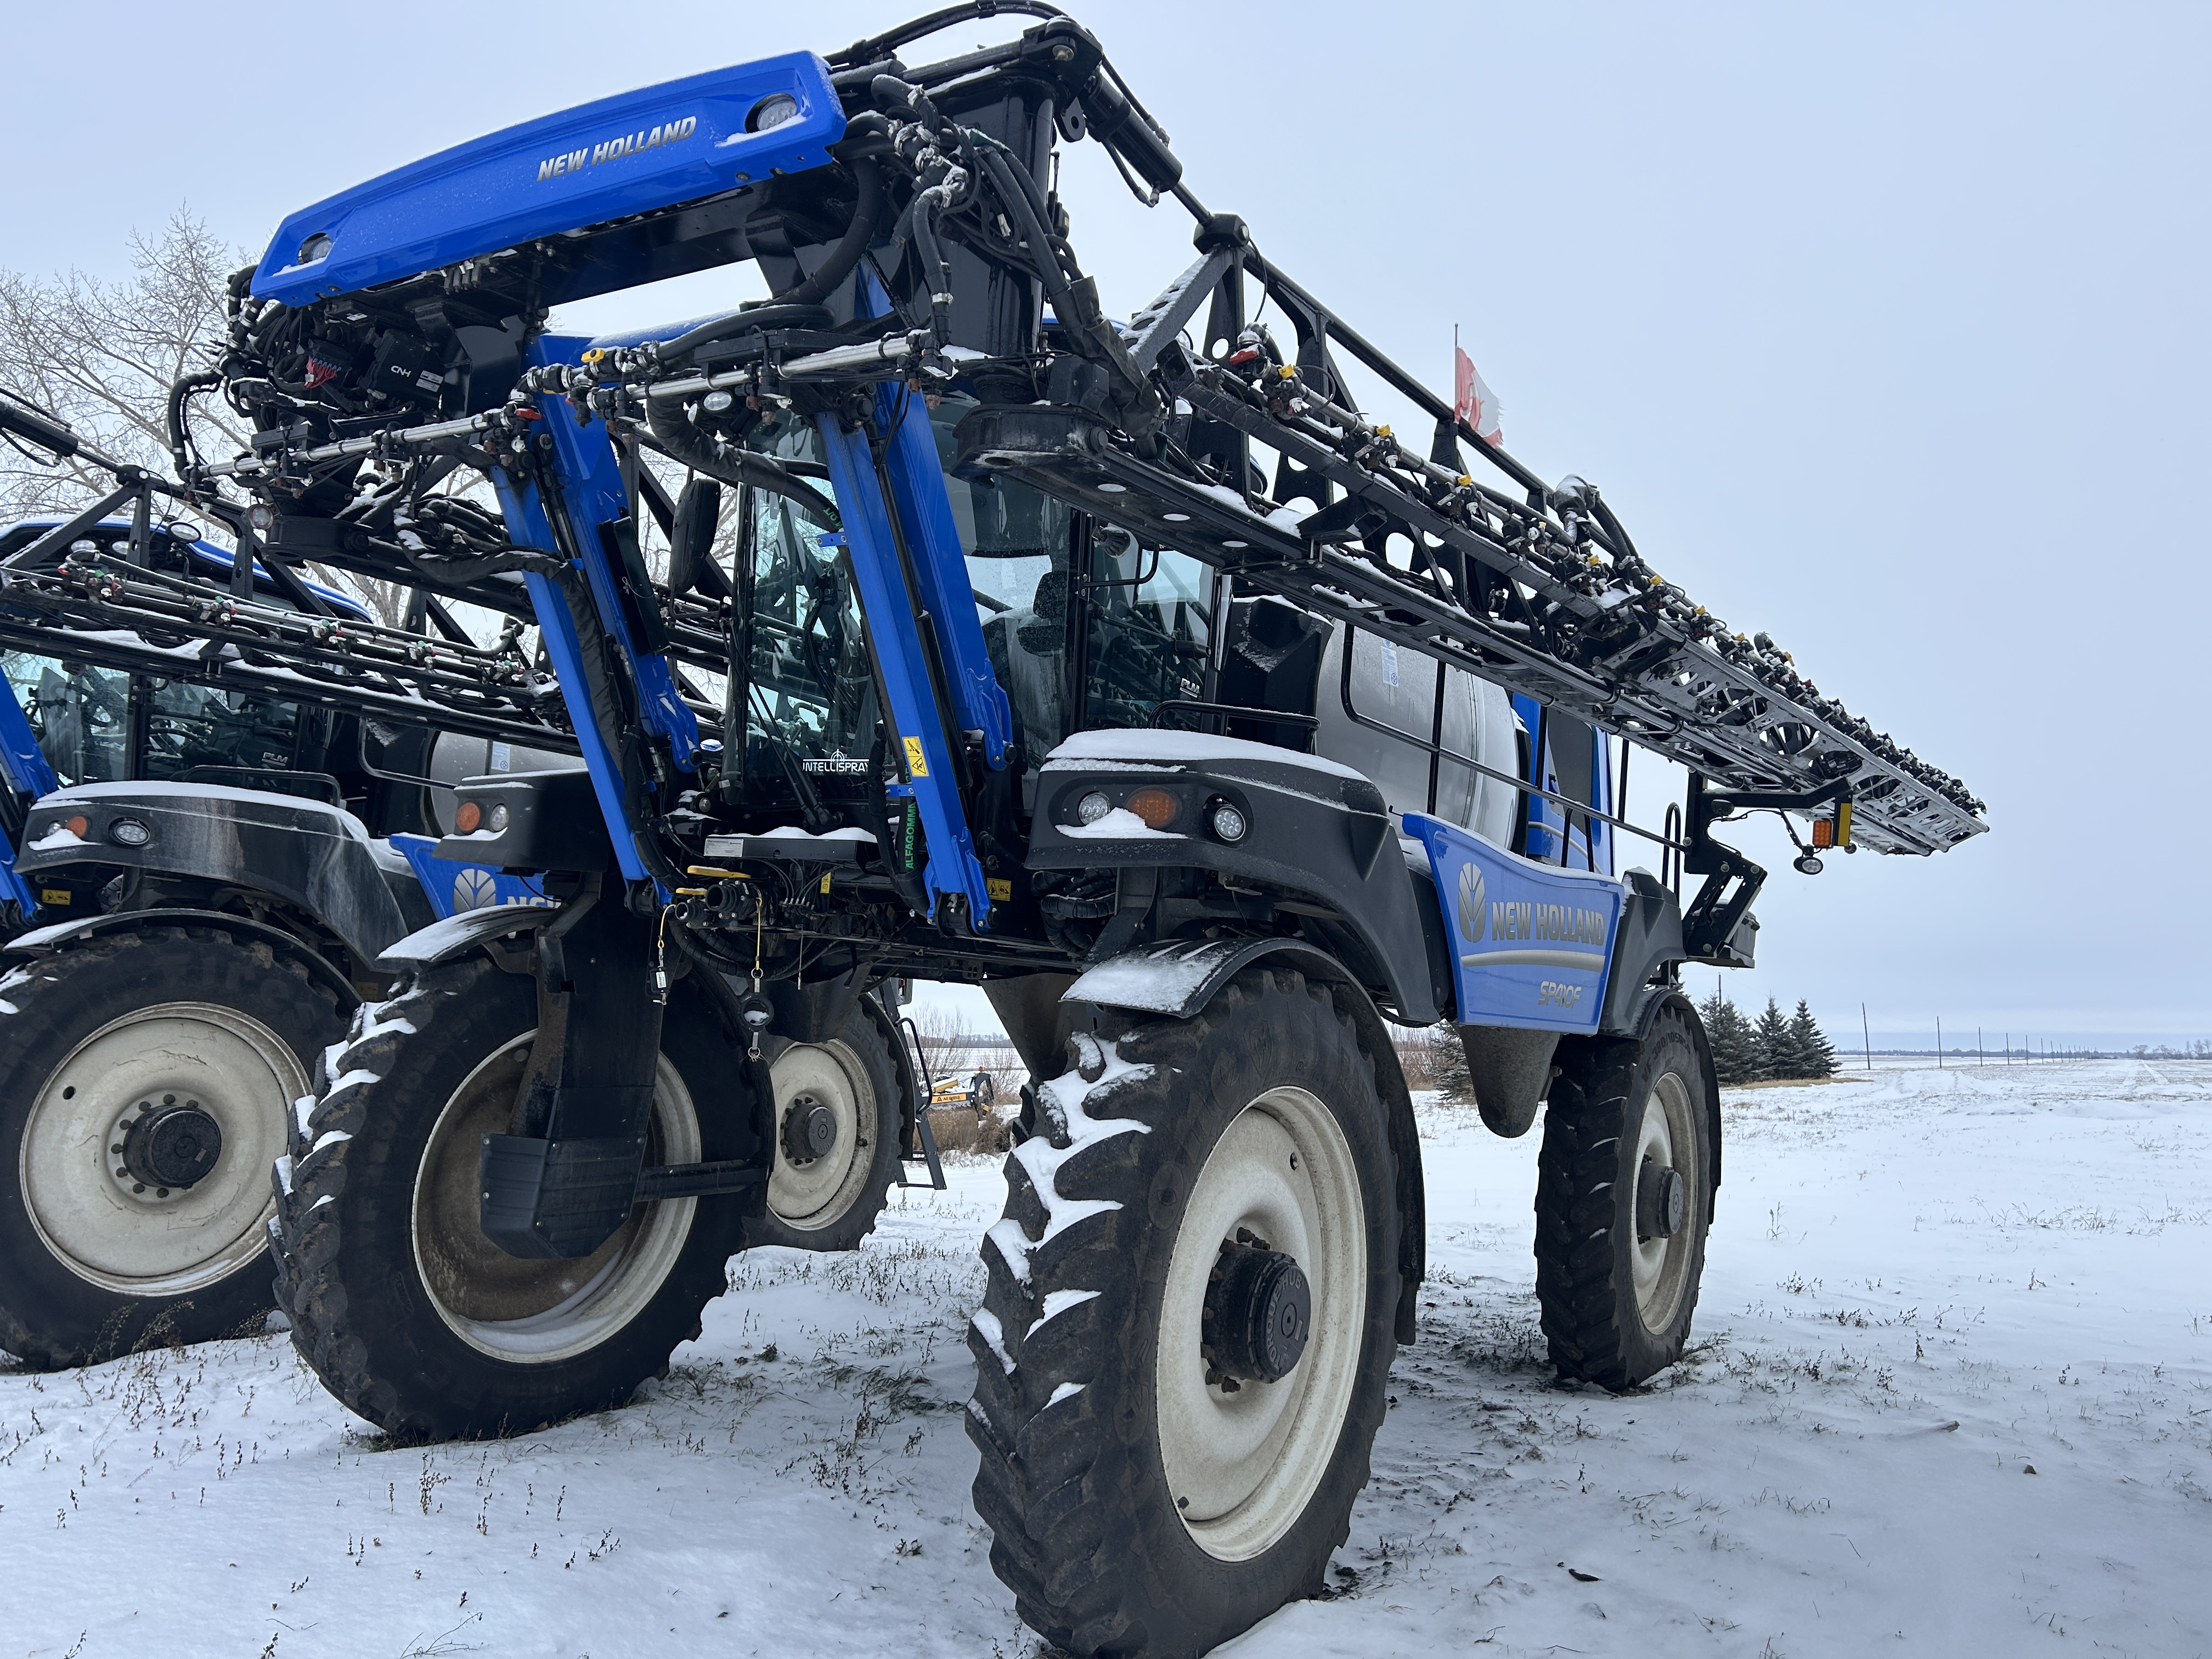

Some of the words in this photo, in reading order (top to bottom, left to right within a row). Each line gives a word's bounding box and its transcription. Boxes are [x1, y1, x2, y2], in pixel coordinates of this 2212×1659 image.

[536, 148, 589, 183] NEW
[590, 115, 697, 167] HOLLAND
[391, 365, 411, 377] CNH
[1180, 678, 1200, 694] PLM
[263, 752, 289, 764] PLM
[802, 761, 868, 772] INTELLISPRAY
[905, 802, 916, 869] ALFAGOMMA
[1492, 901, 1532, 941] NEW
[1536, 902, 1605, 946] HOLLAND
[1538, 981, 1582, 1009] SP410F
